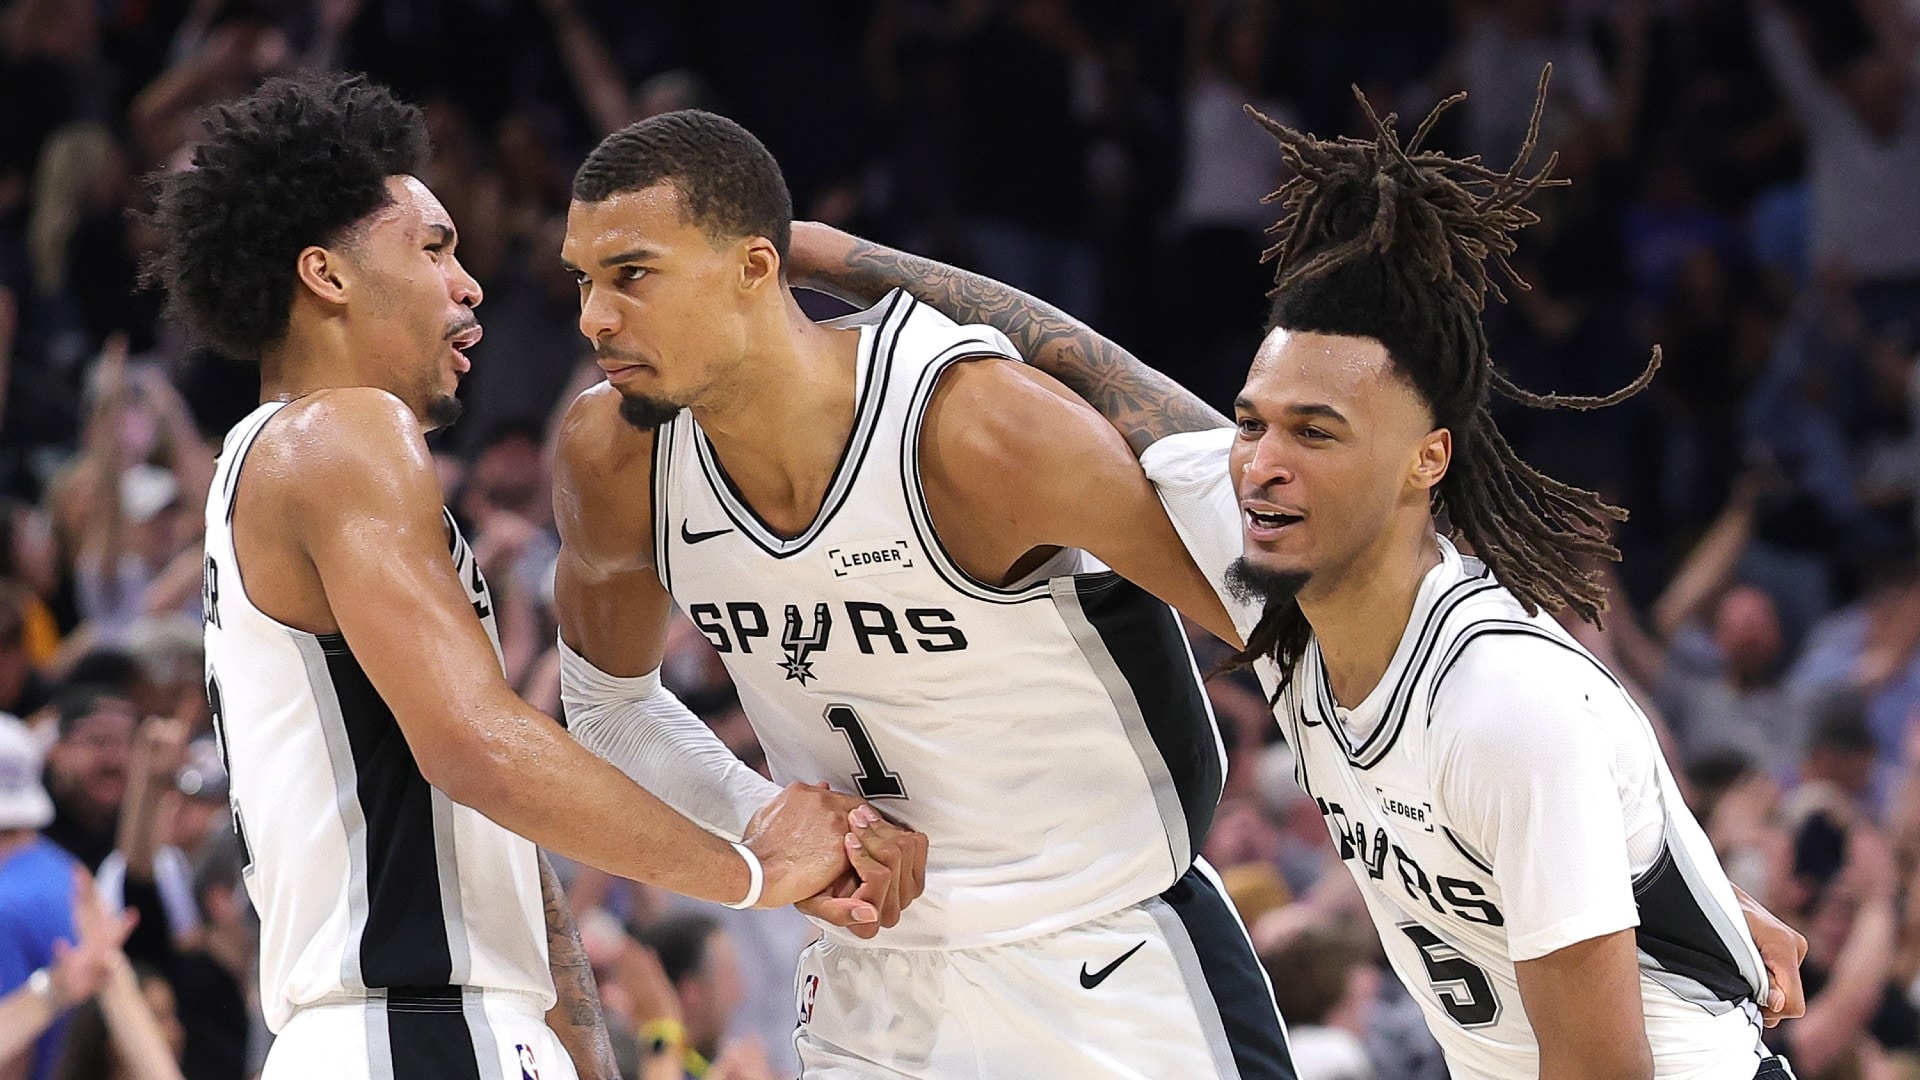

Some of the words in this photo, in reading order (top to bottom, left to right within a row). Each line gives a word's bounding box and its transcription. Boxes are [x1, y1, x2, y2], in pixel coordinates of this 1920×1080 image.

[841, 549, 902, 568] LEDGER
[690, 601, 968, 687] SPURS
[822, 703, 909, 800] 1
[1383, 797, 1426, 823] LEDGER
[1395, 920, 1503, 1029] 5
